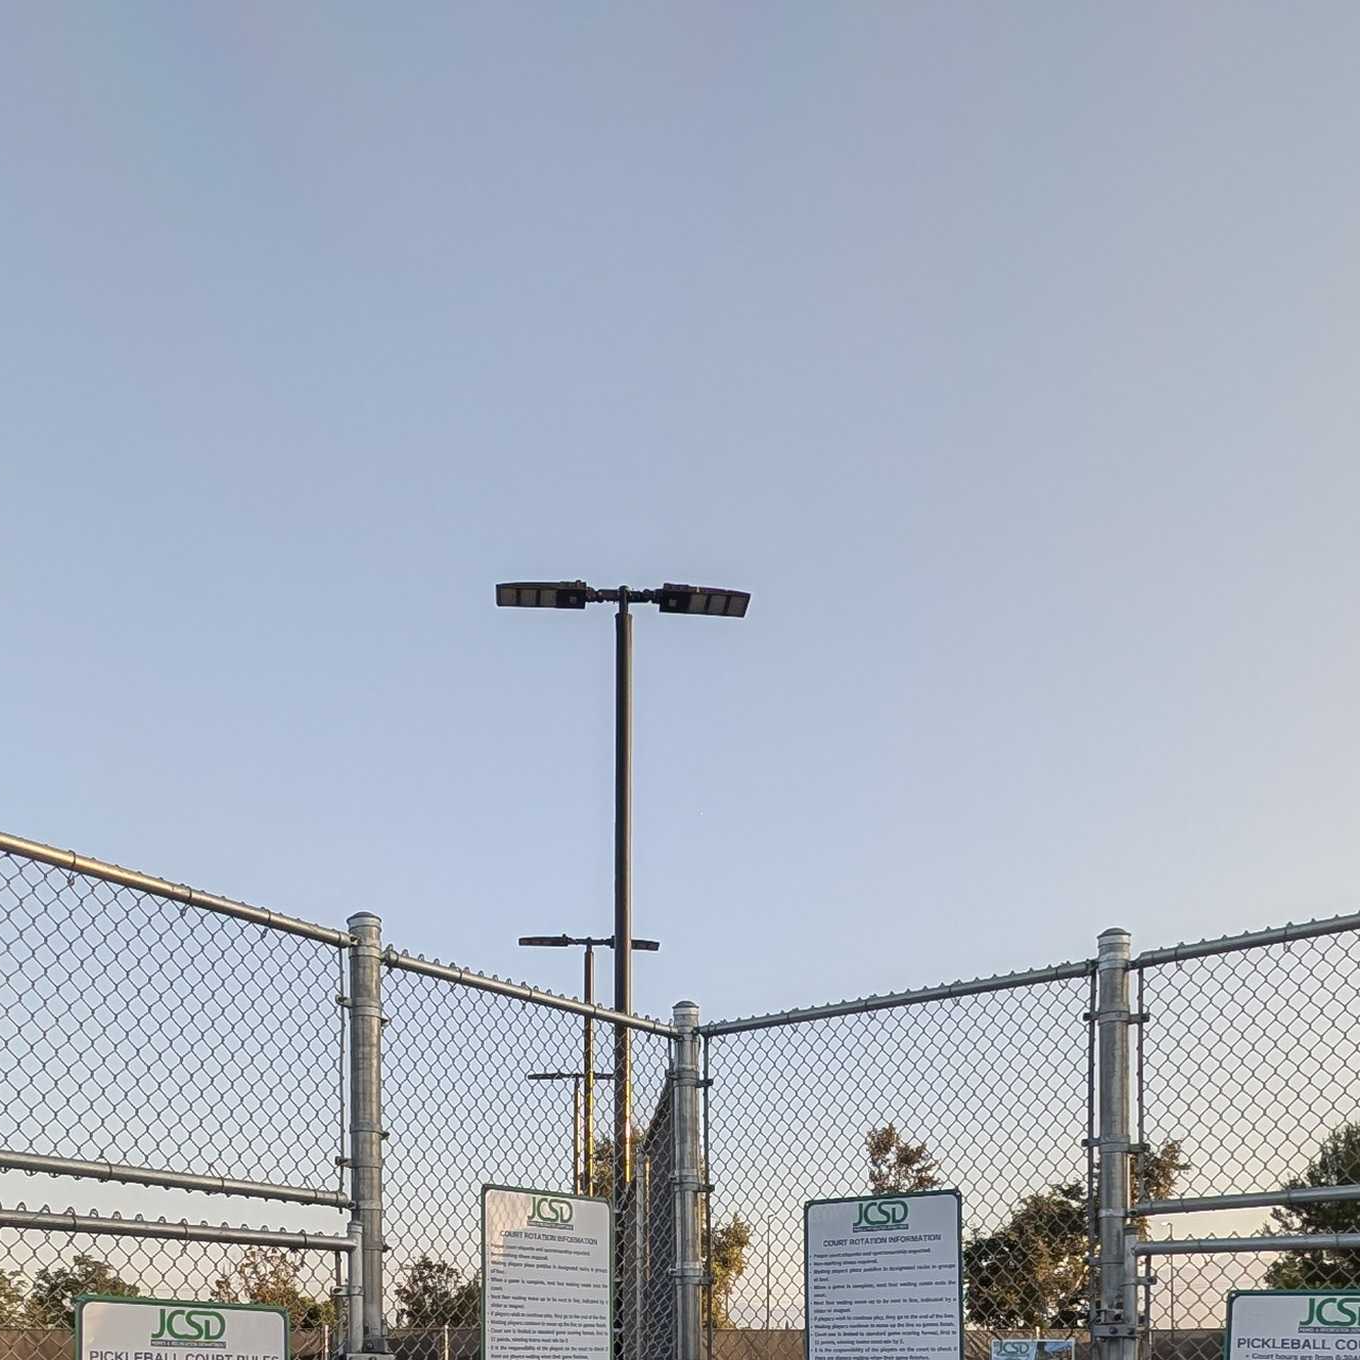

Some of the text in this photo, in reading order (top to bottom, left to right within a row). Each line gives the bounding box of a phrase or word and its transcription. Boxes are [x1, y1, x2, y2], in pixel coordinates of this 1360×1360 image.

[528, 1196, 573, 1223] JCSD
[853, 1201, 909, 1226] JCSD
[823, 1238, 848, 1248] COURT
[849, 1236, 888, 1247] ROTATION
[151, 1308, 226, 1340] JCSD
[997, 1342, 1030, 1356] JCSD
[1236, 1337, 1331, 1350] PICKLEBALL
